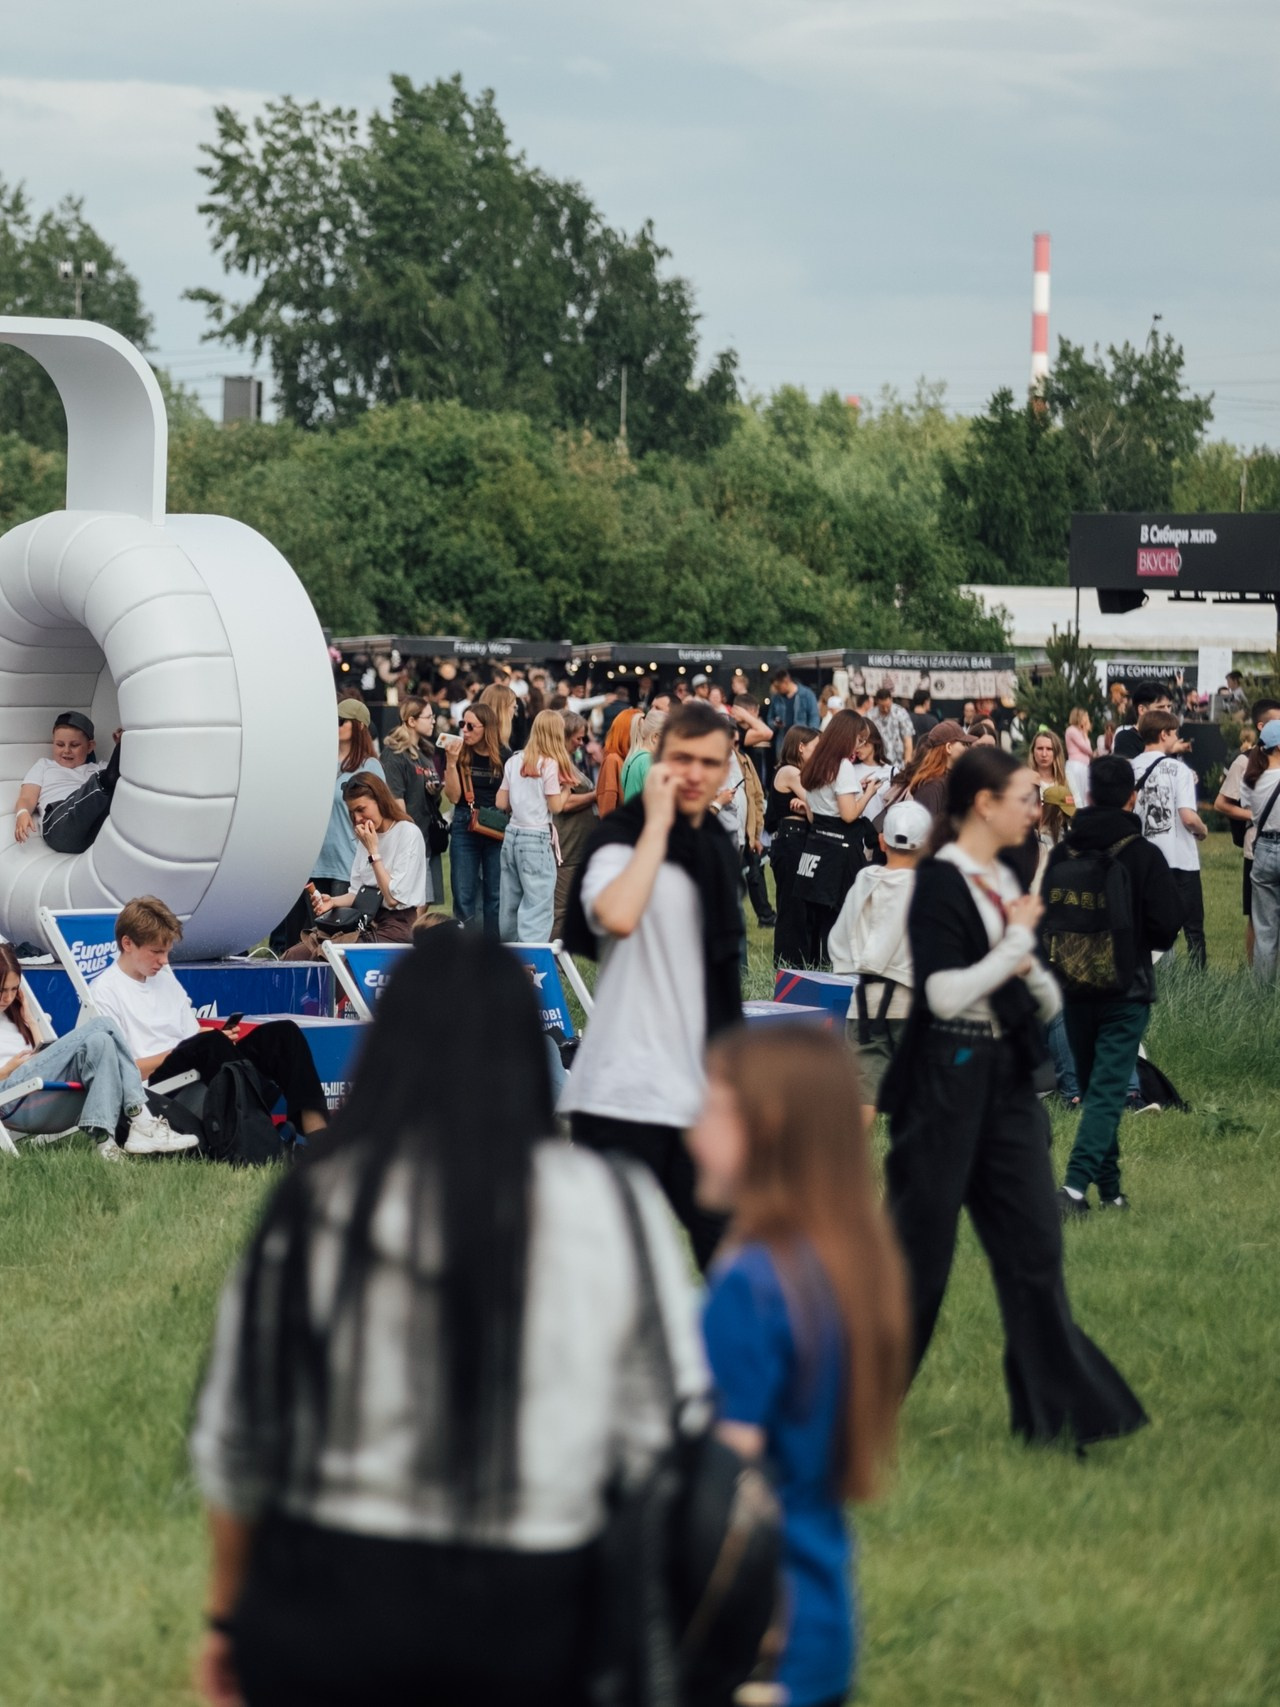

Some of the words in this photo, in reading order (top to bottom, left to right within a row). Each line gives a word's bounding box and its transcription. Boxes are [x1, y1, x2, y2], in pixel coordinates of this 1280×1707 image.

[1140, 524, 1149, 544] В
[1150, 524, 1189, 548] Сибири
[1190, 529, 1217, 544] жить
[1139, 551, 1182, 572] ВКУСНО
[929, 656, 969, 669] IZAKAYA
[970, 657, 992, 669] BAR
[1126, 665, 1185, 678] COMMUNITY
